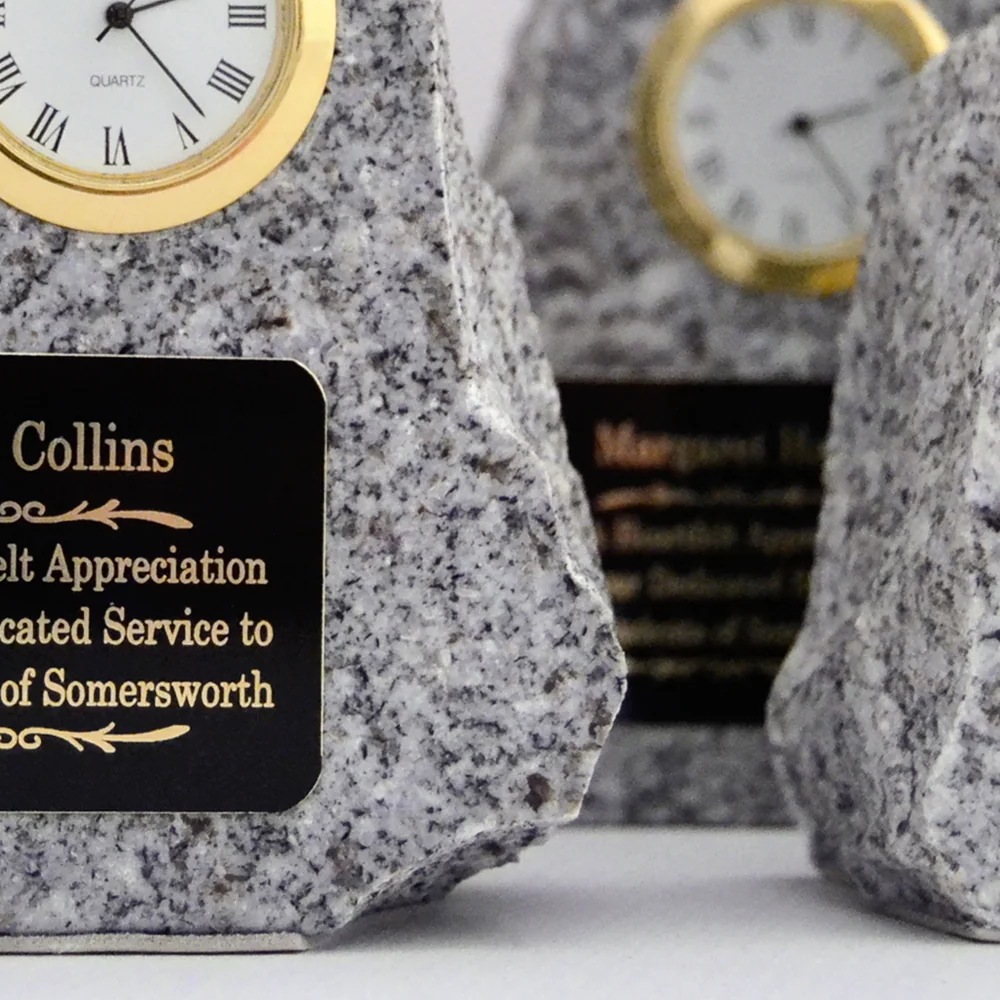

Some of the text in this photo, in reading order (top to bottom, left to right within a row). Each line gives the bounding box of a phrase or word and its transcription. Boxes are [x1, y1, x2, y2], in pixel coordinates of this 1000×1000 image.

[228, 5, 266, 28] III
[89, 74, 145, 88] QUARTZ
[27, 103, 68, 153] VII
[104, 127, 130, 165] VI
[172, 112, 199, 150] V
[13, 421, 173, 472] Collins
[43, 544, 268, 591] Appreciation
[103, 606, 229, 646] Service
[240, 612, 273, 646] to
[0, 668, 34, 707] of
[43, 668, 275, 708] Somersworth
